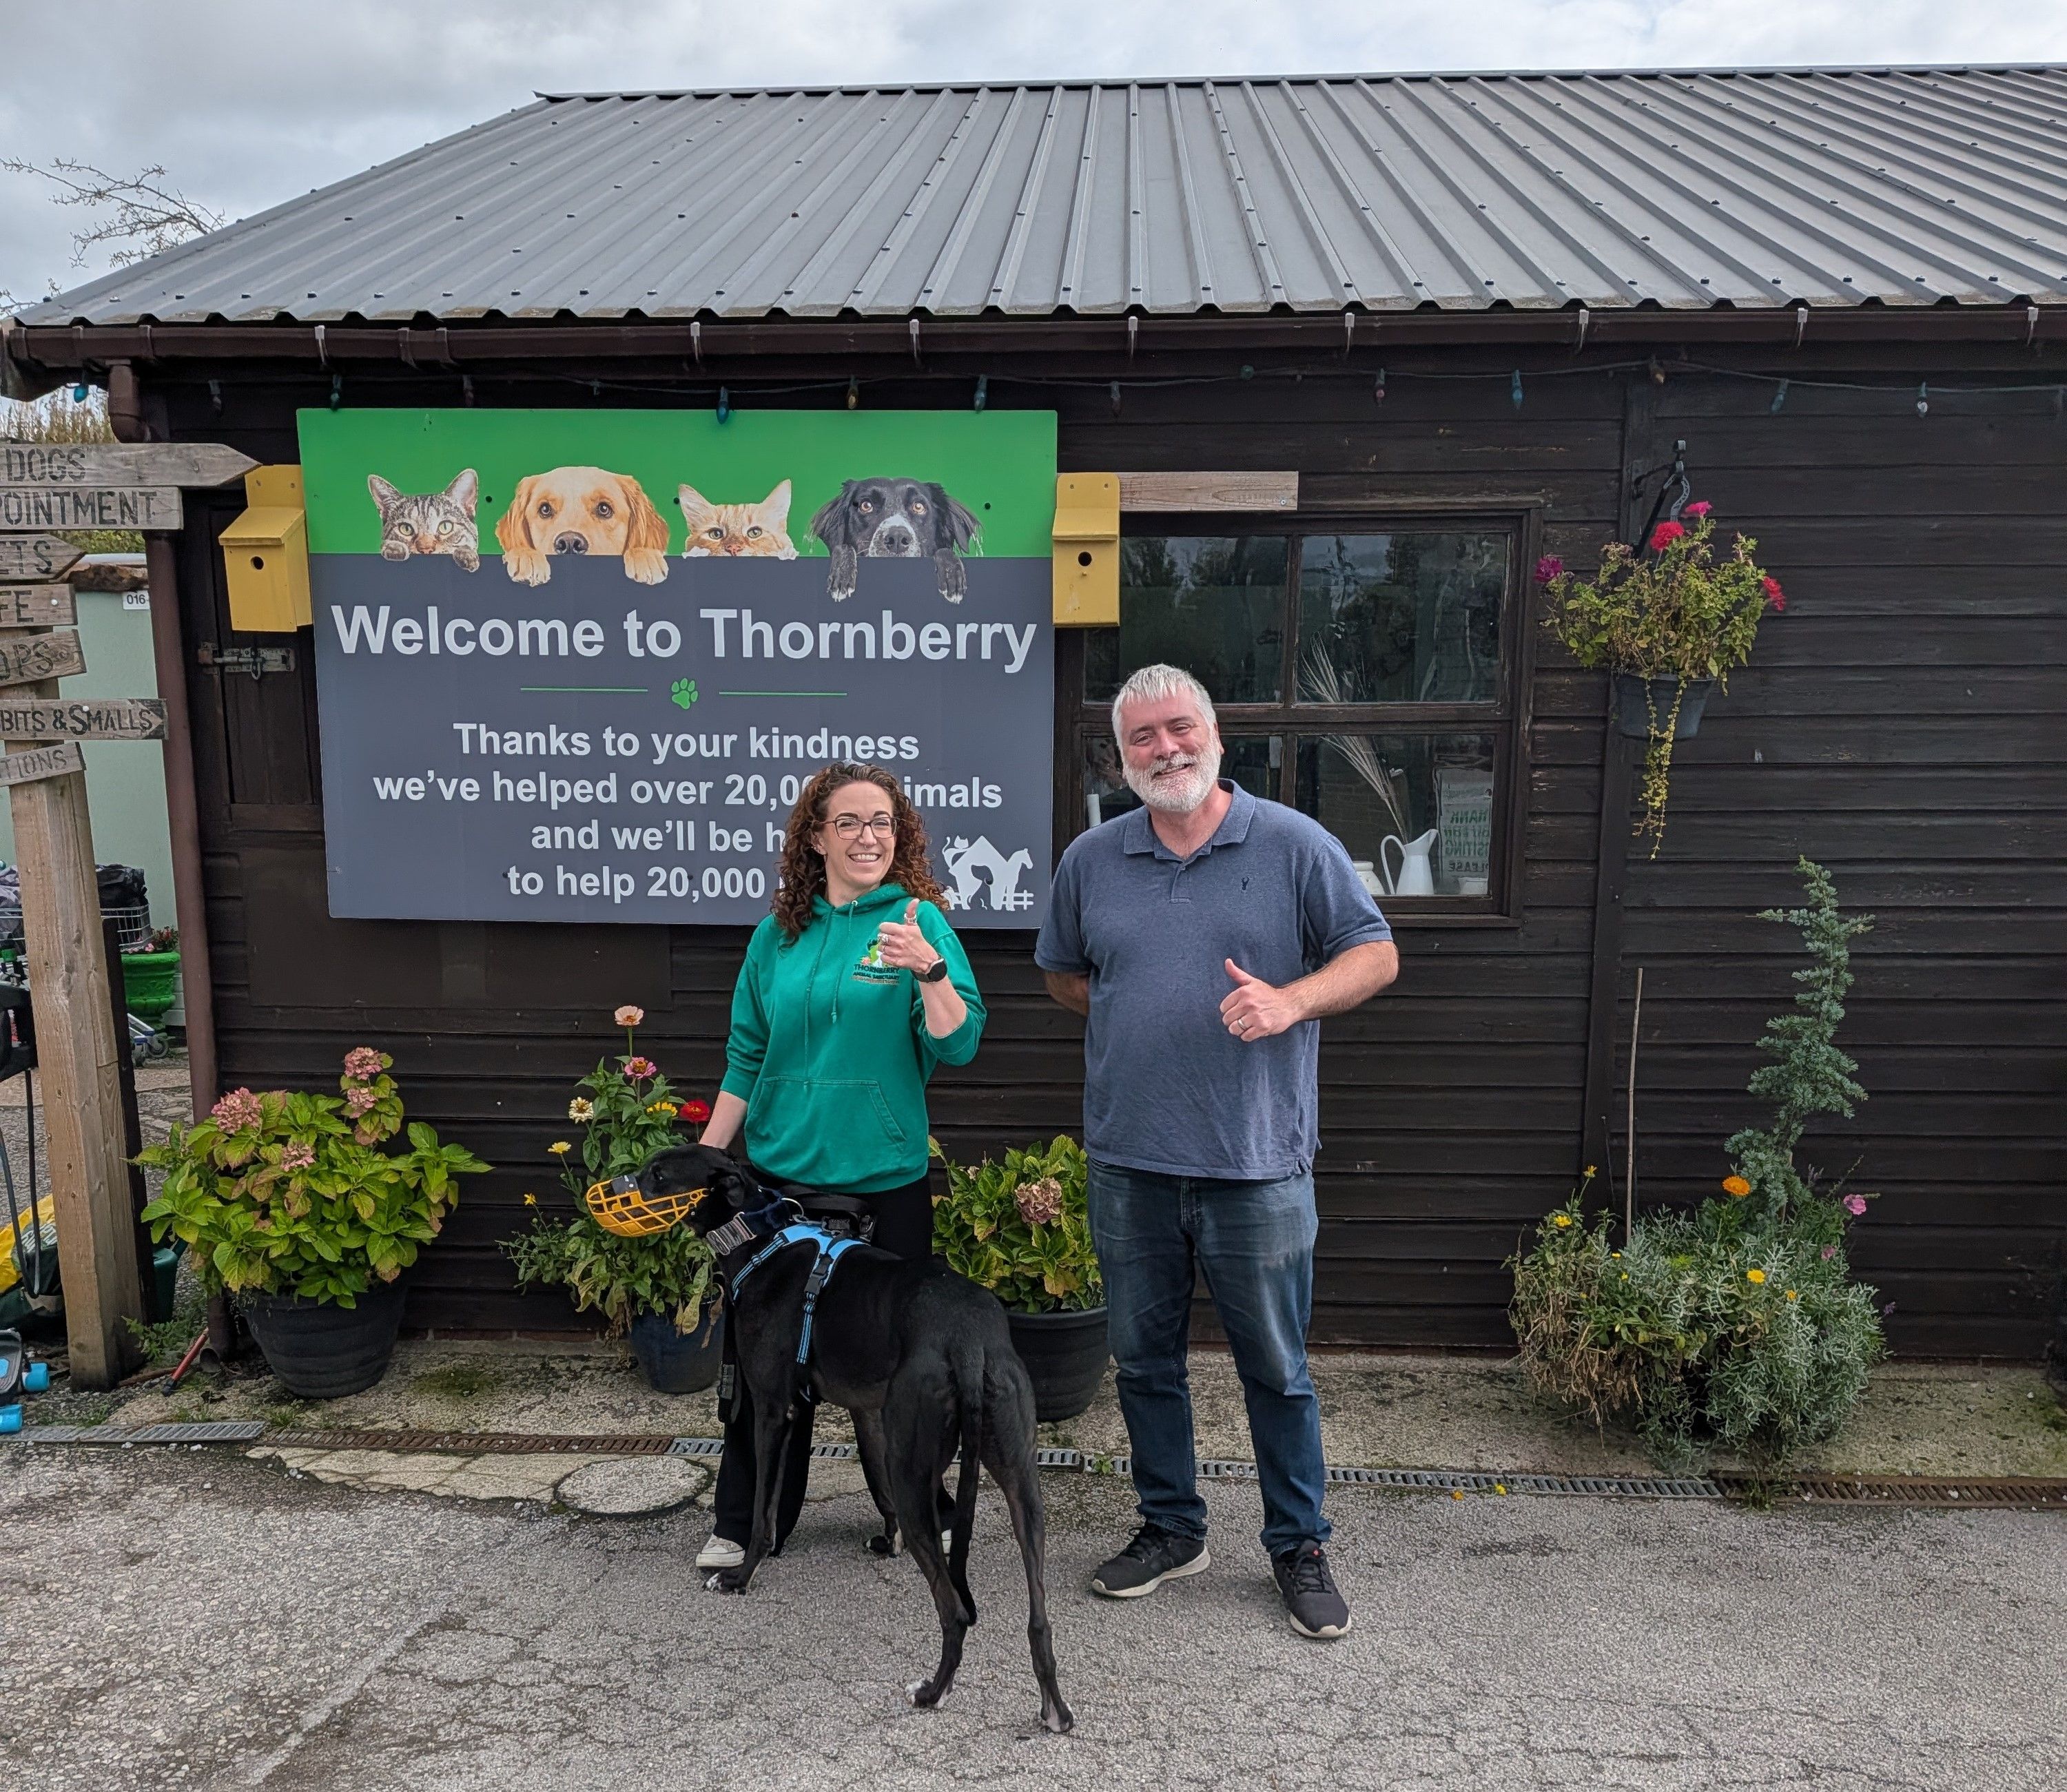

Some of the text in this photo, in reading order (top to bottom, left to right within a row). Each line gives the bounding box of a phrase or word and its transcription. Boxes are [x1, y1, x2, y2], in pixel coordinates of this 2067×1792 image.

[6, 447, 86, 482] DOGS
[0, 491, 158, 525] OINTMENT
[126, 594, 146, 605] 016
[331, 605, 1037, 674] Welcome to Thornberry
[52, 708, 68, 731] &
[453, 723, 919, 765] Thanks to your kindness
[373, 770, 480, 801] we’ve
[493, 771, 617, 810] helped
[630, 780, 714, 805] over
[725, 774, 816, 812] 20,0
[531, 819, 599, 849] and
[610, 820, 695, 851] we’ll
[709, 821, 752, 852] be
[507, 865, 765, 904] to help 20,000
[854, 963, 900, 974] THORNBERRY
